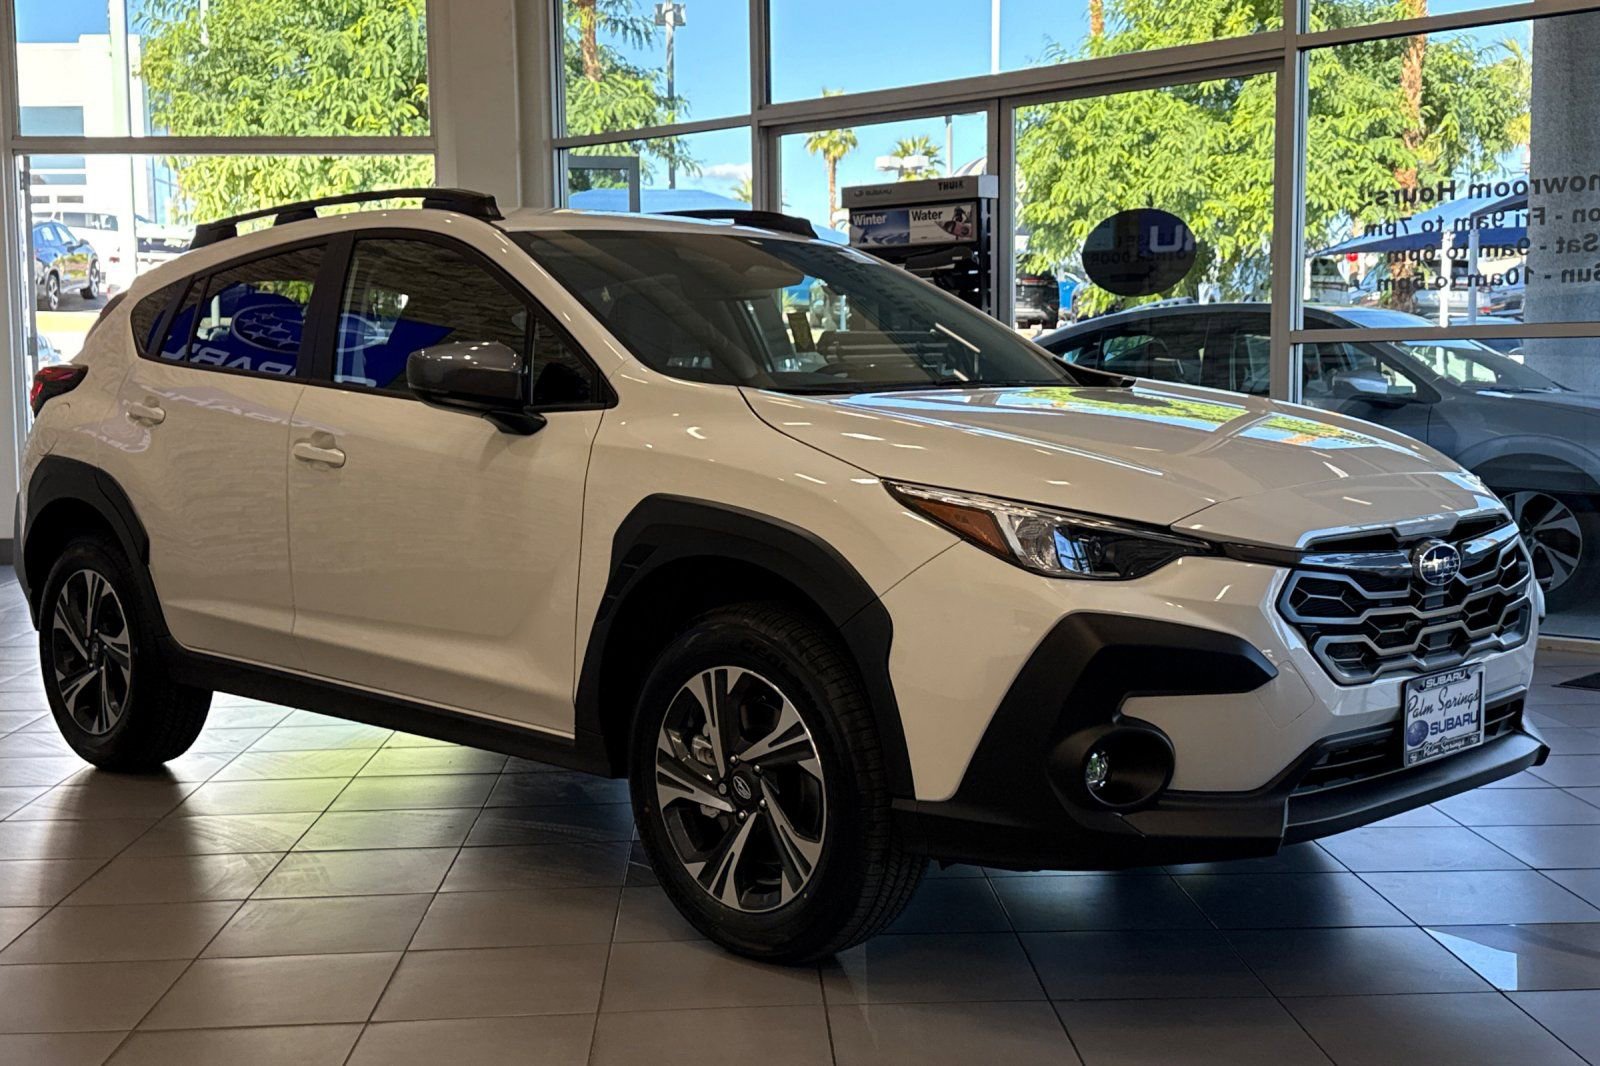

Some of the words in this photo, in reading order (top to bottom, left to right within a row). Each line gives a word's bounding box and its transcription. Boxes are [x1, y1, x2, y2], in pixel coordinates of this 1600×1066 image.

[852, 213, 888, 226] Winter
[911, 209, 944, 222] Water
[1425, 670, 1467, 688] SUBARU
[1408, 694, 1434, 718] Palm
[1437, 686, 1480, 717] Springs
[1429, 710, 1479, 736] SUBARU
